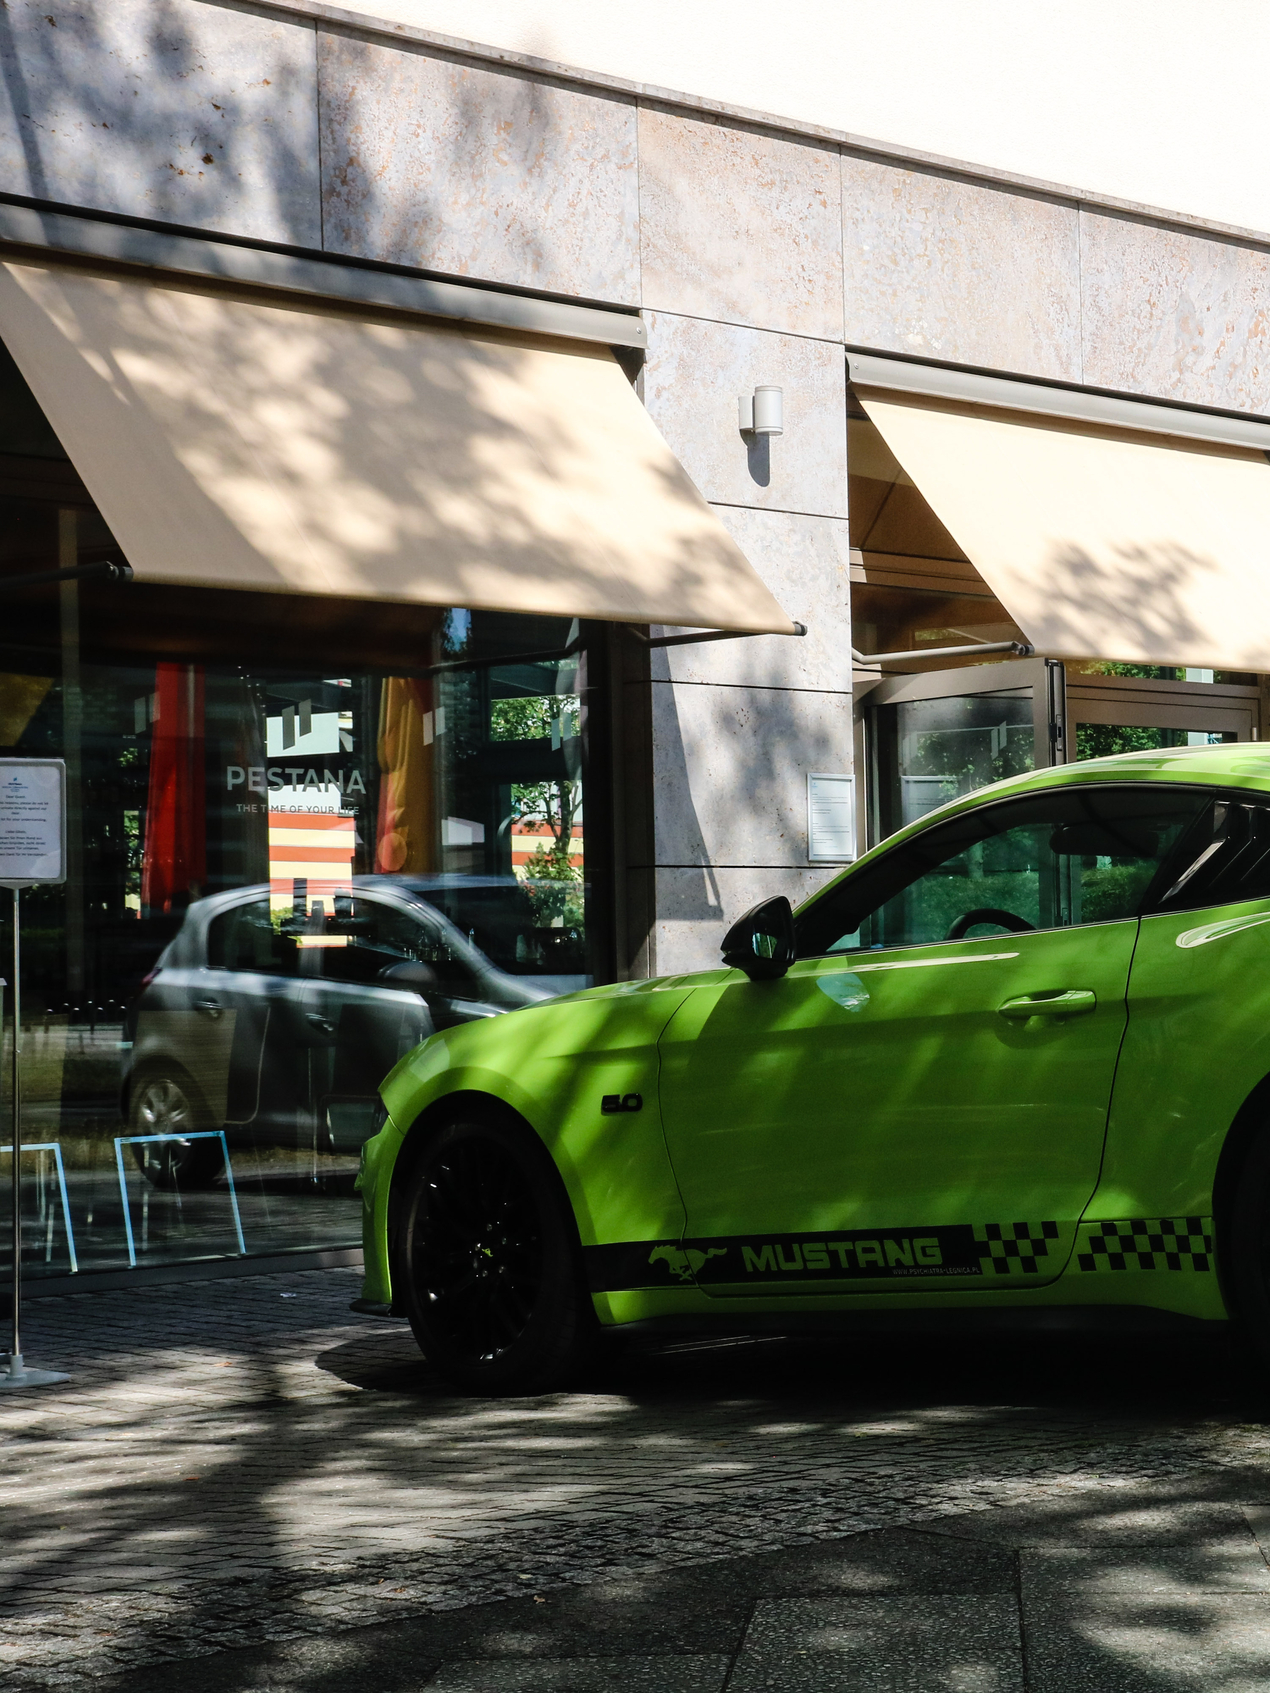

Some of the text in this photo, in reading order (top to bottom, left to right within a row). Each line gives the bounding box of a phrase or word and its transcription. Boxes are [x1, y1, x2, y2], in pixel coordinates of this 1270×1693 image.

[226, 766, 367, 794] PESTANA
[236, 803, 258, 813] THE
[289, 805, 304, 813] OF
[306, 805, 336, 814] YOUR
[338, 806, 360, 815] LIFE
[741, 1237, 943, 1272] MUSTANG
